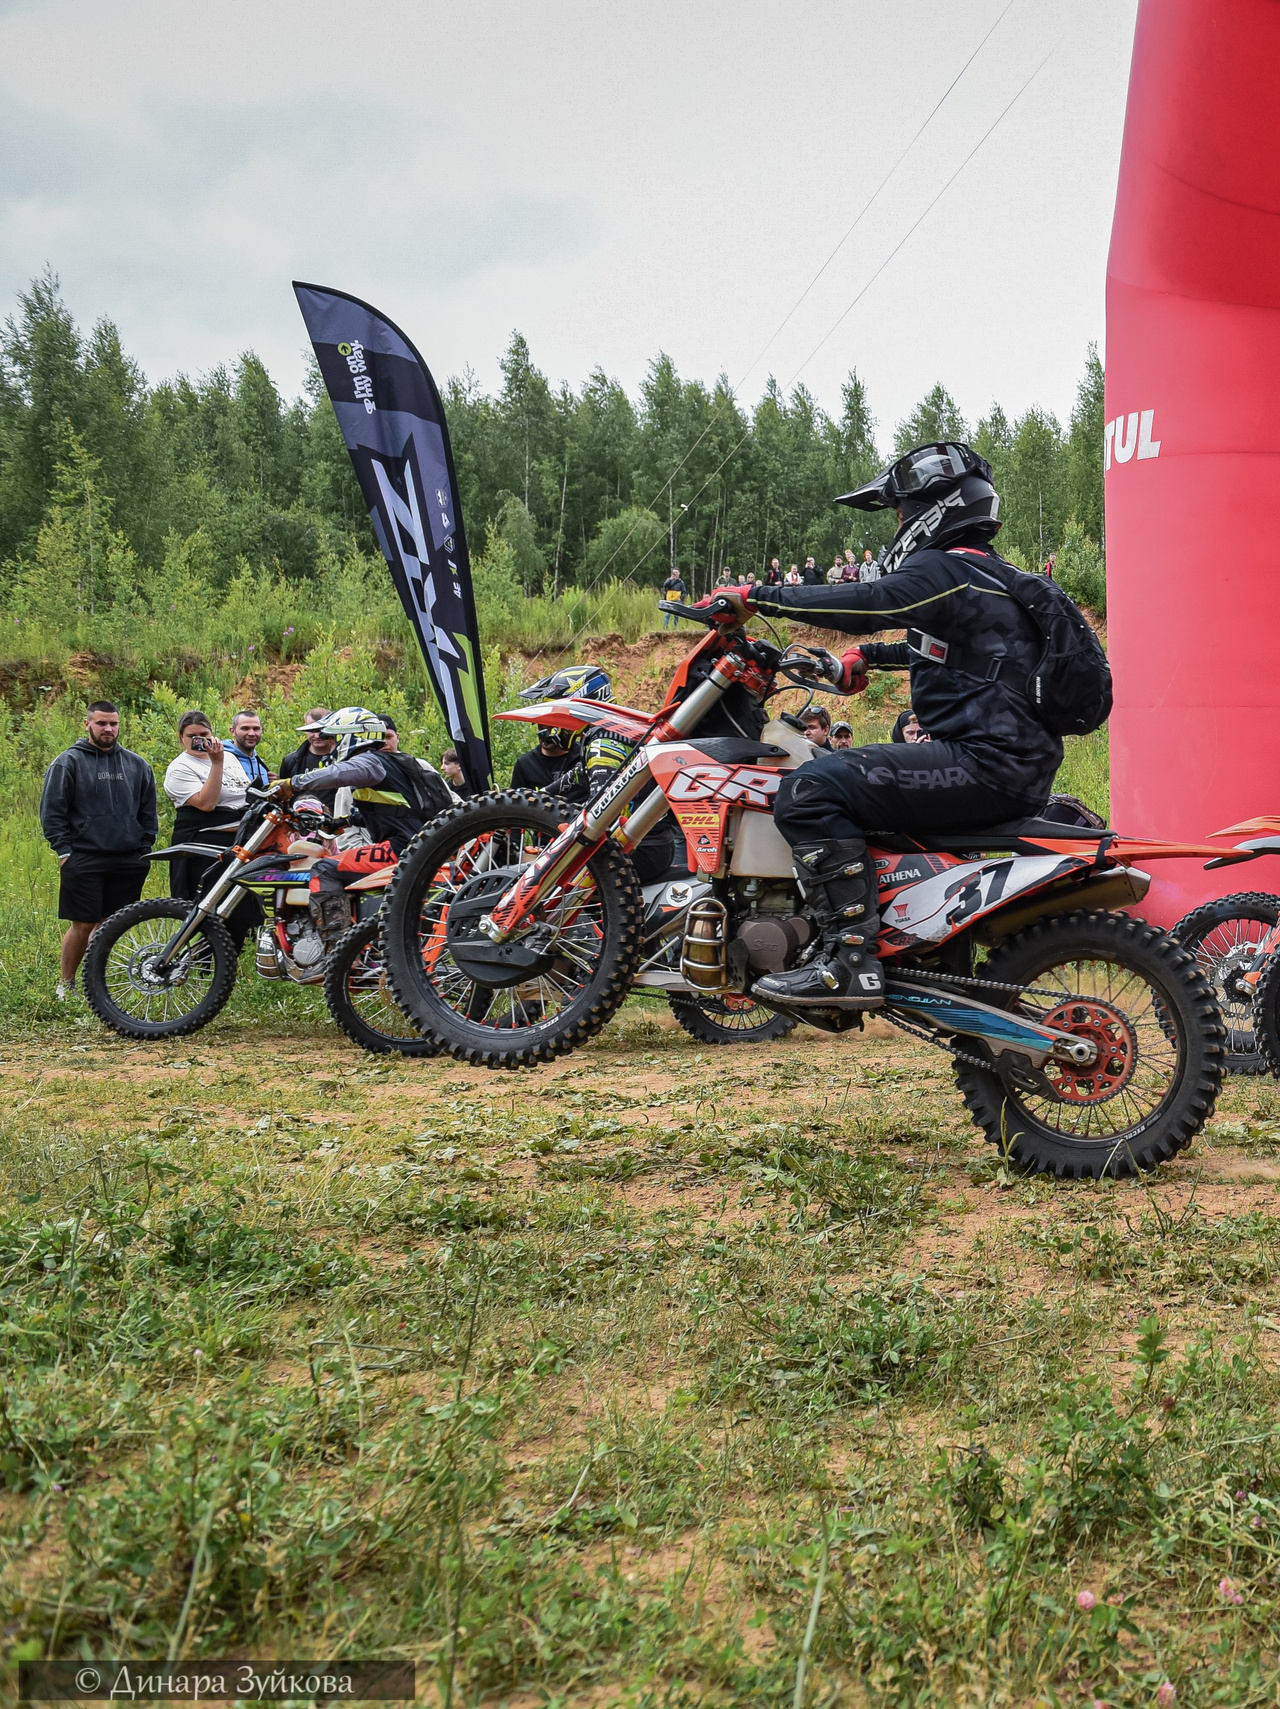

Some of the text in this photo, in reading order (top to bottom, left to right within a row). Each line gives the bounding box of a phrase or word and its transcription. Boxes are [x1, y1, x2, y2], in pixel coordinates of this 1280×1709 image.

[346, 355, 359, 374] on
[361, 374, 374, 398] my
[681, 816, 715, 825] DHL
[355, 846, 397, 863] FOX
[878, 868, 921, 884] ATHENA
[944, 860, 1014, 926] 37
[895, 916, 911, 924] YUASA
[858, 972, 881, 991] G
